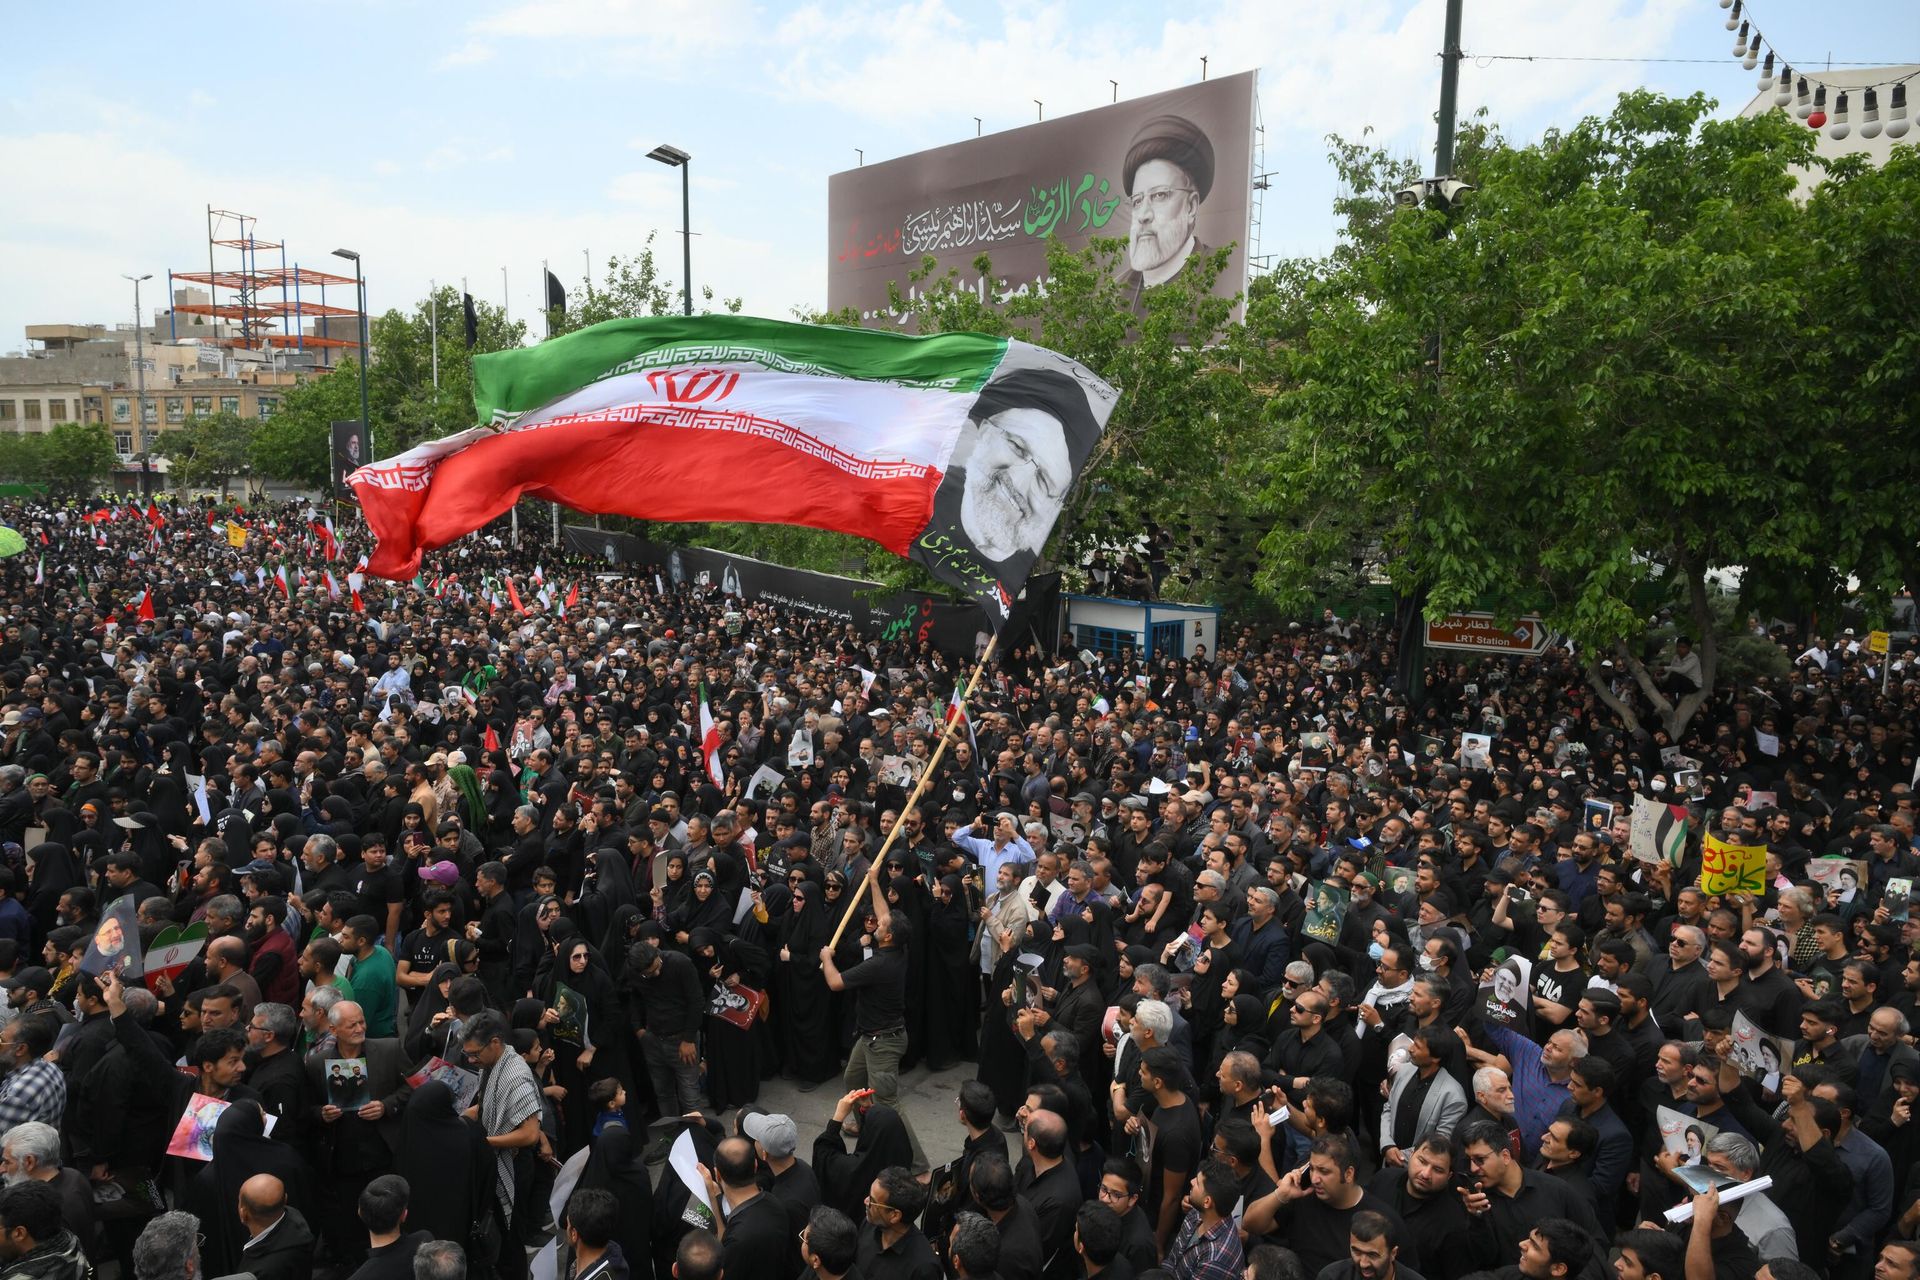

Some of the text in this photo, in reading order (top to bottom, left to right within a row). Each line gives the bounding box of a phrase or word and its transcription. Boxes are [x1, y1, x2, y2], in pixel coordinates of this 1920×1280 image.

[1072, 172, 1120, 233] خادم
[1431, 618, 1463, 630] شهری
[1465, 620, 1490, 630] قطار
[1455, 634, 1510, 646] LRT Station
[1537, 973, 1563, 1003] FILA
